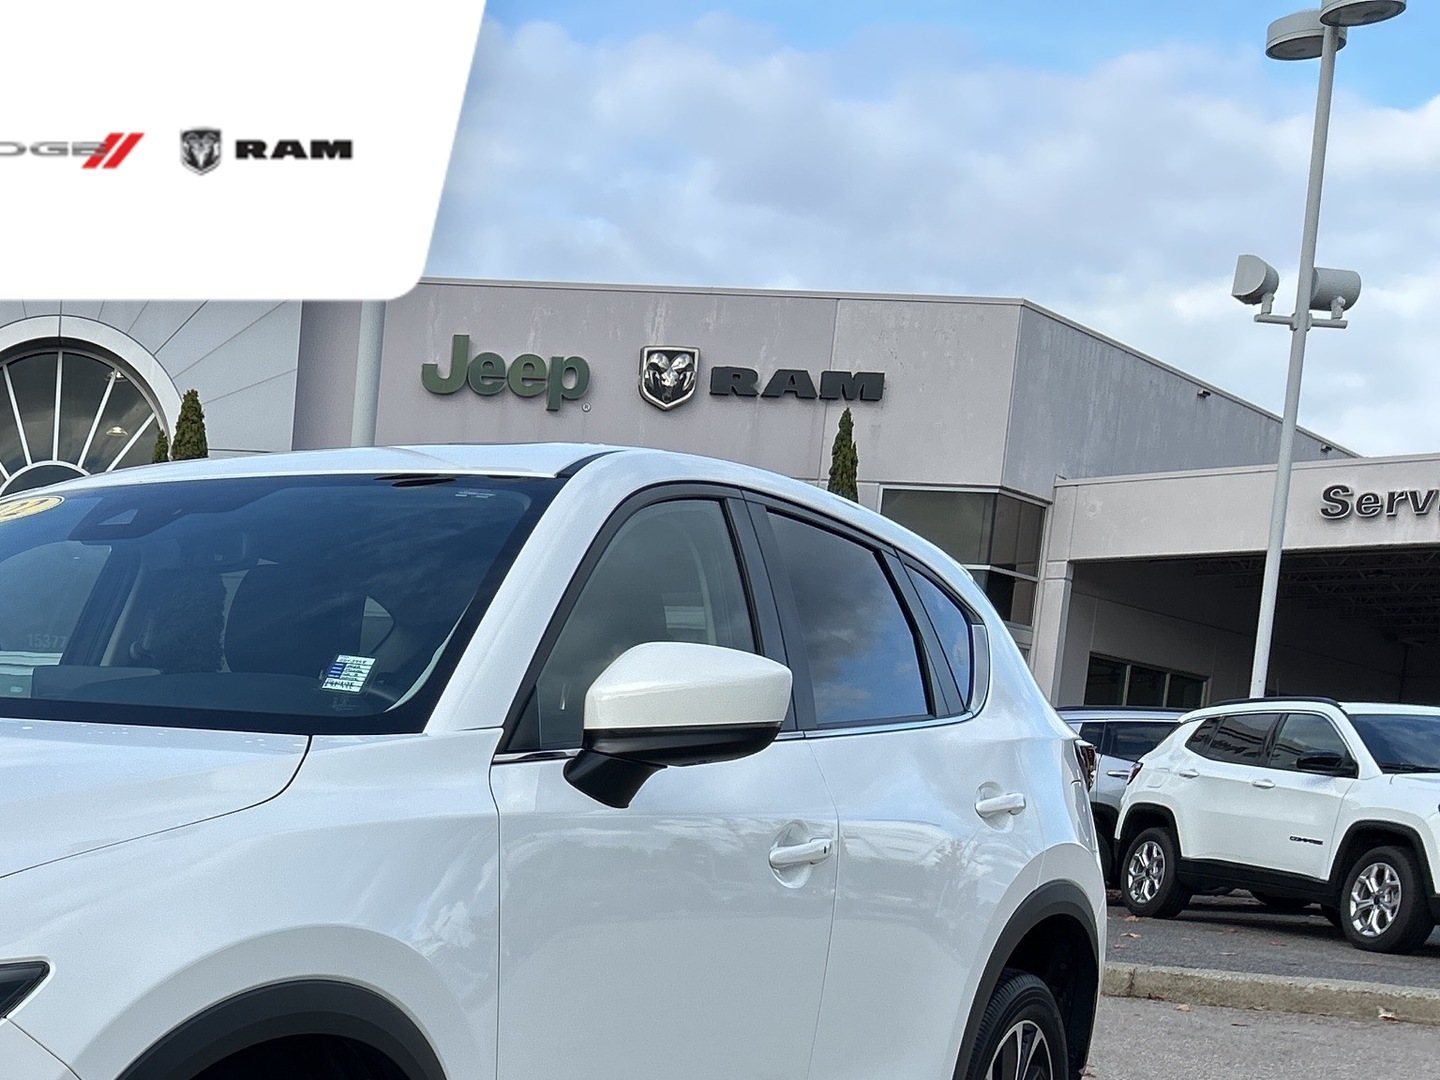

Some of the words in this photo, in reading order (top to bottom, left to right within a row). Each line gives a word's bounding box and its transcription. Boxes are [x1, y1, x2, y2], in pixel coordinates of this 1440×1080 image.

[421, 334, 590, 411] Jeep
[709, 366, 886, 402] RAM
[1320, 484, 1440, 520] Serv
[27, 633, 67, 649] 15377
